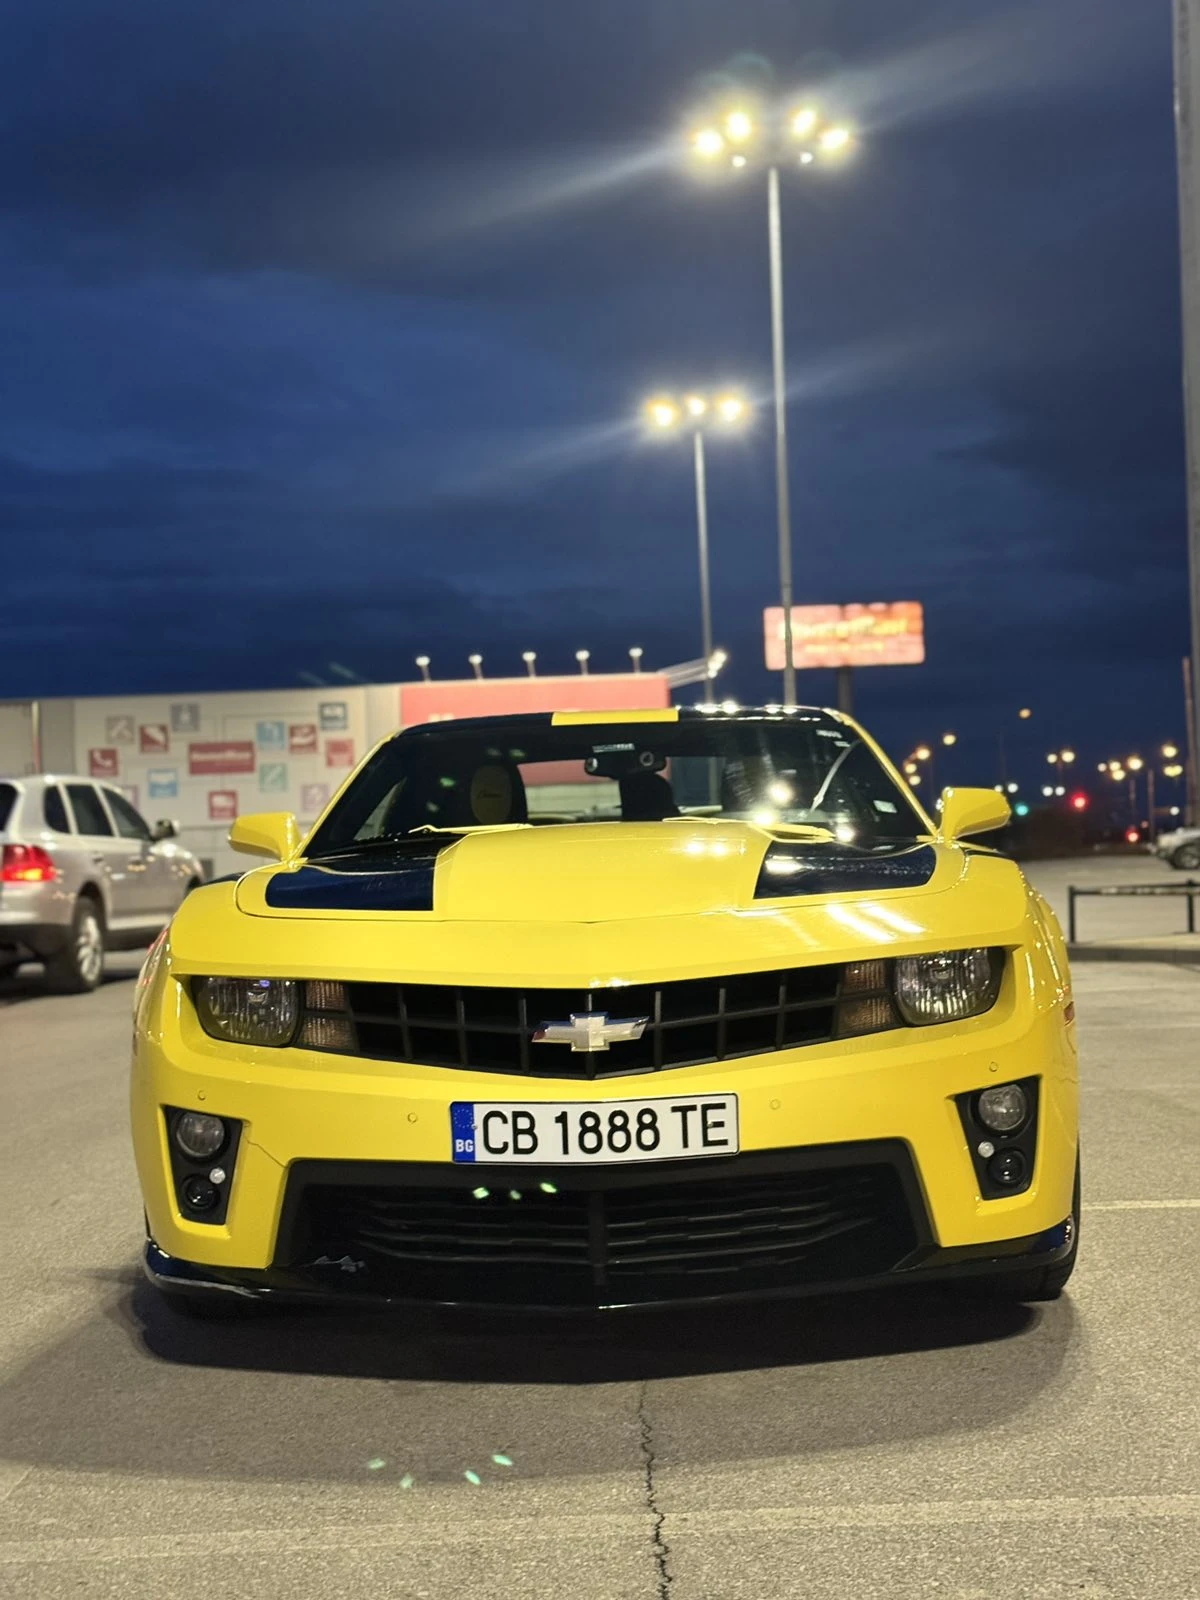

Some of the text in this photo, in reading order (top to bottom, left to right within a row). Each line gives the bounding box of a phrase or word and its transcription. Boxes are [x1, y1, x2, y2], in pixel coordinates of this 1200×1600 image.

[482, 1102, 729, 1155] CB 1888 TE
[455, 1139, 474, 1153] BG
